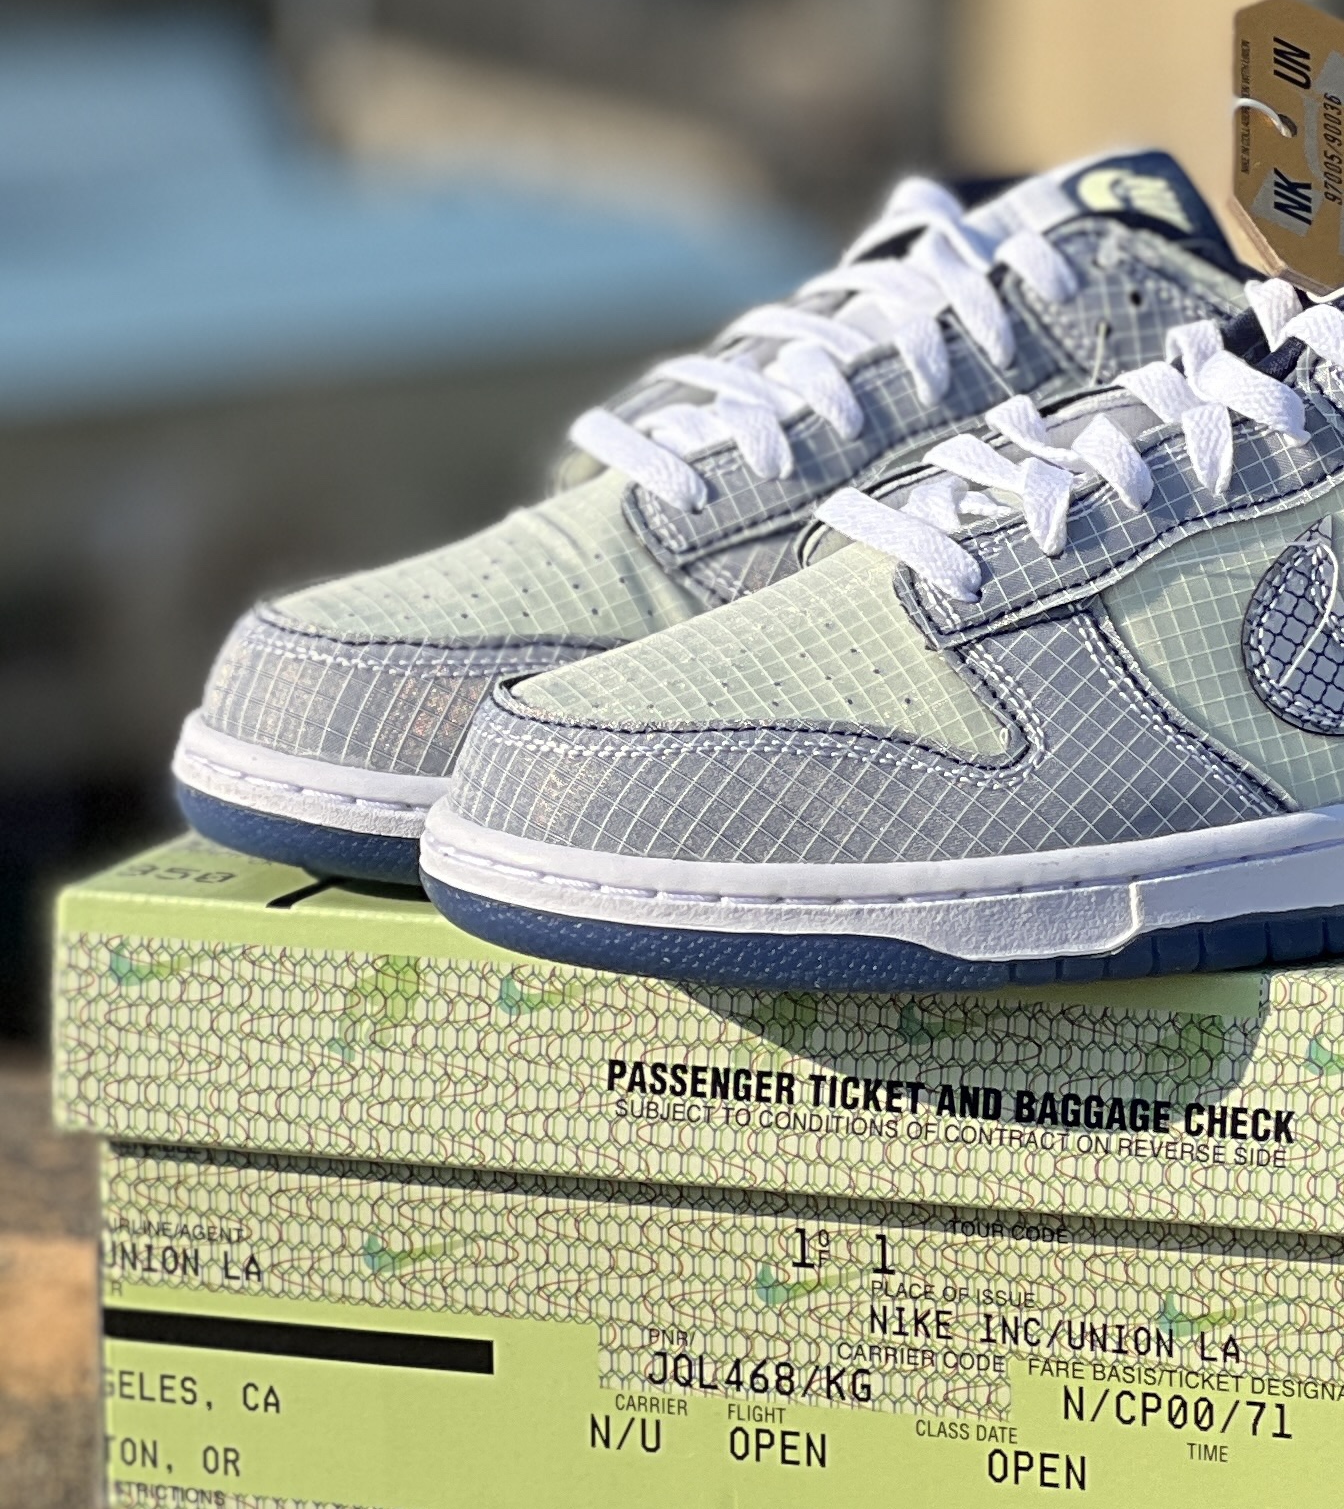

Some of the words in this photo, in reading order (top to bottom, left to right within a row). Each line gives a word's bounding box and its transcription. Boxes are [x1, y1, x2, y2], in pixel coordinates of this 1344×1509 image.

[1272, 36, 1311, 90] UN
[1323, 92, 1343, 206] 97005/90036
[1273, 167, 1312, 225] NK
[607, 1058, 795, 1106] PASSENGER
[808, 1073, 928, 1115] TICKET
[936, 1084, 1002, 1121] AND
[1014, 1090, 1172, 1135] BAGGAGE
[1184, 1102, 1296, 1144] CHECK
[614, 1098, 716, 1124] SUBJECT
[723, 1106, 752, 1127] TO
[758, 1108, 900, 1139] CONDITIONS
[906, 1121, 938, 1141] OF
[944, 1123, 1070, 1152] CONTRACT
[1076, 1134, 1111, 1155] ON
[1118, 1137, 1226, 1166] REVERSE
[1233, 1146, 1288, 1169] SIDE
[792, 1227, 815, 1269] 1
[872, 1234, 896, 1275] 1
[949, 1219, 1005, 1241] TOUR
[1010, 1223, 1070, 1245] CODE
[223, 1250, 263, 1283] LA
[870, 1280, 935, 1301] PLACE
[942, 1285, 969, 1303] OF
[976, 1288, 1036, 1309] ISSUE
[649, 1328, 696, 1347] PNR/
[869, 1304, 954, 1340] NIKE
[979, 1312, 1174, 1358] INC/UNION
[1199, 1330, 1241, 1364] LA
[836, 1341, 936, 1369] CARRIER
[942, 1351, 1006, 1373] CODE
[1028, 1357, 1085, 1380] FARE
[1091, 1363, 1242, 1393] BASIS/TICKET
[648, 1351, 873, 1403] JQL468/KG
[242, 1381, 281, 1414] CA
[614, 1393, 689, 1416] CARRIER
[727, 1402, 787, 1424] FLIGHT
[1063, 1384, 1293, 1440] N/CP00/71
[589, 1412, 663, 1454] N/U
[729, 1425, 827, 1469] OPEN
[915, 1419, 970, 1442] CLASS
[976, 1423, 1018, 1445] DATE
[202, 1444, 241, 1477] OR
[987, 1448, 1087, 1491] OPEN
[1186, 1442, 1229, 1463] TIME
